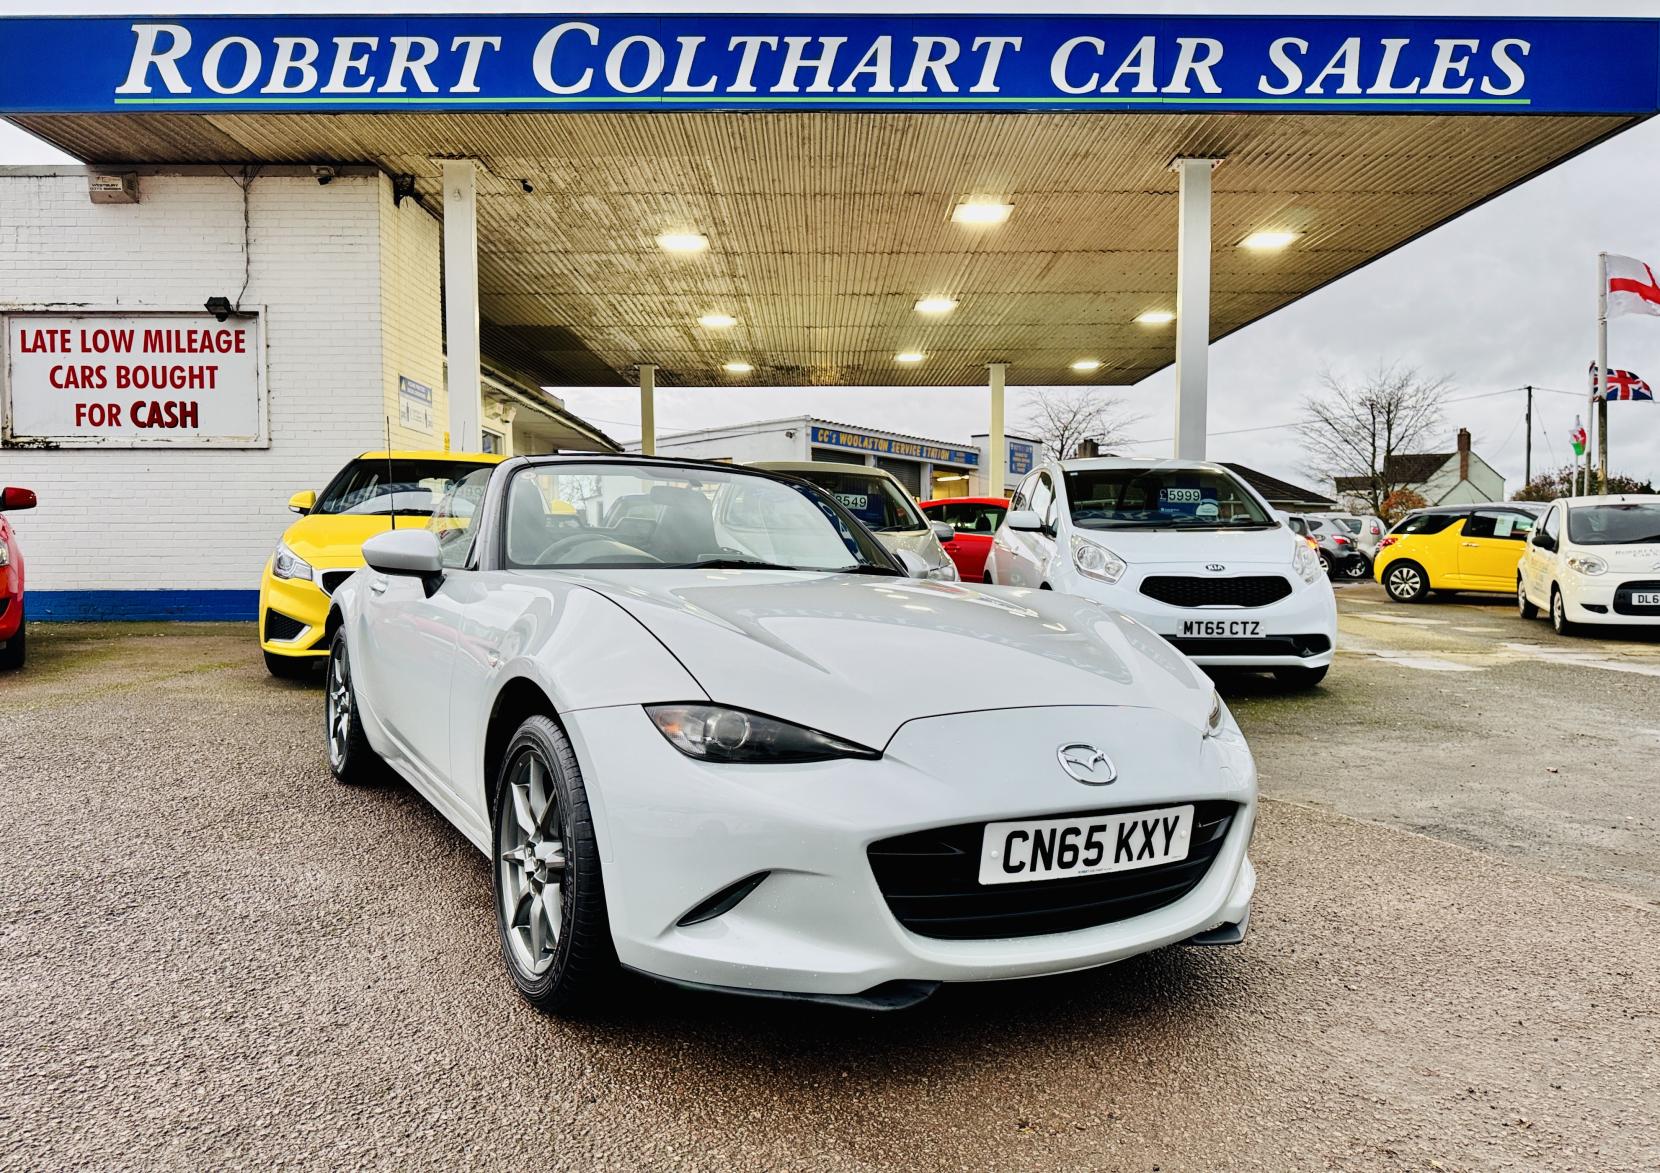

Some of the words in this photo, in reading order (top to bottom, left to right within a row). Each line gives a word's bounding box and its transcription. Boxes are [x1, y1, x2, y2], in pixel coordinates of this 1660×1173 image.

[115, 23, 502, 95] ROBERT
[531, 21, 1023, 95] COLTHART
[1049, 36, 1225, 95] CAR
[1258, 37, 1532, 97] SALES
[20, 329, 71, 353] LATE
[80, 329, 135, 353] LOW
[142, 329, 246, 353] MILEAGE
[49, 365, 108, 389] CARS
[116, 365, 219, 389] BOUGHT
[75, 403, 122, 427] FOR
[130, 400, 199, 428] CASH
[891, 441, 921, 457] SERVICE
[922, 446, 950, 461] STATION
[1183, 621, 1225, 635] MT65
[1229, 621, 1260, 635] CTZ
[1002, 823, 1107, 875] CN65
[1113, 815, 1180, 864] KXY
